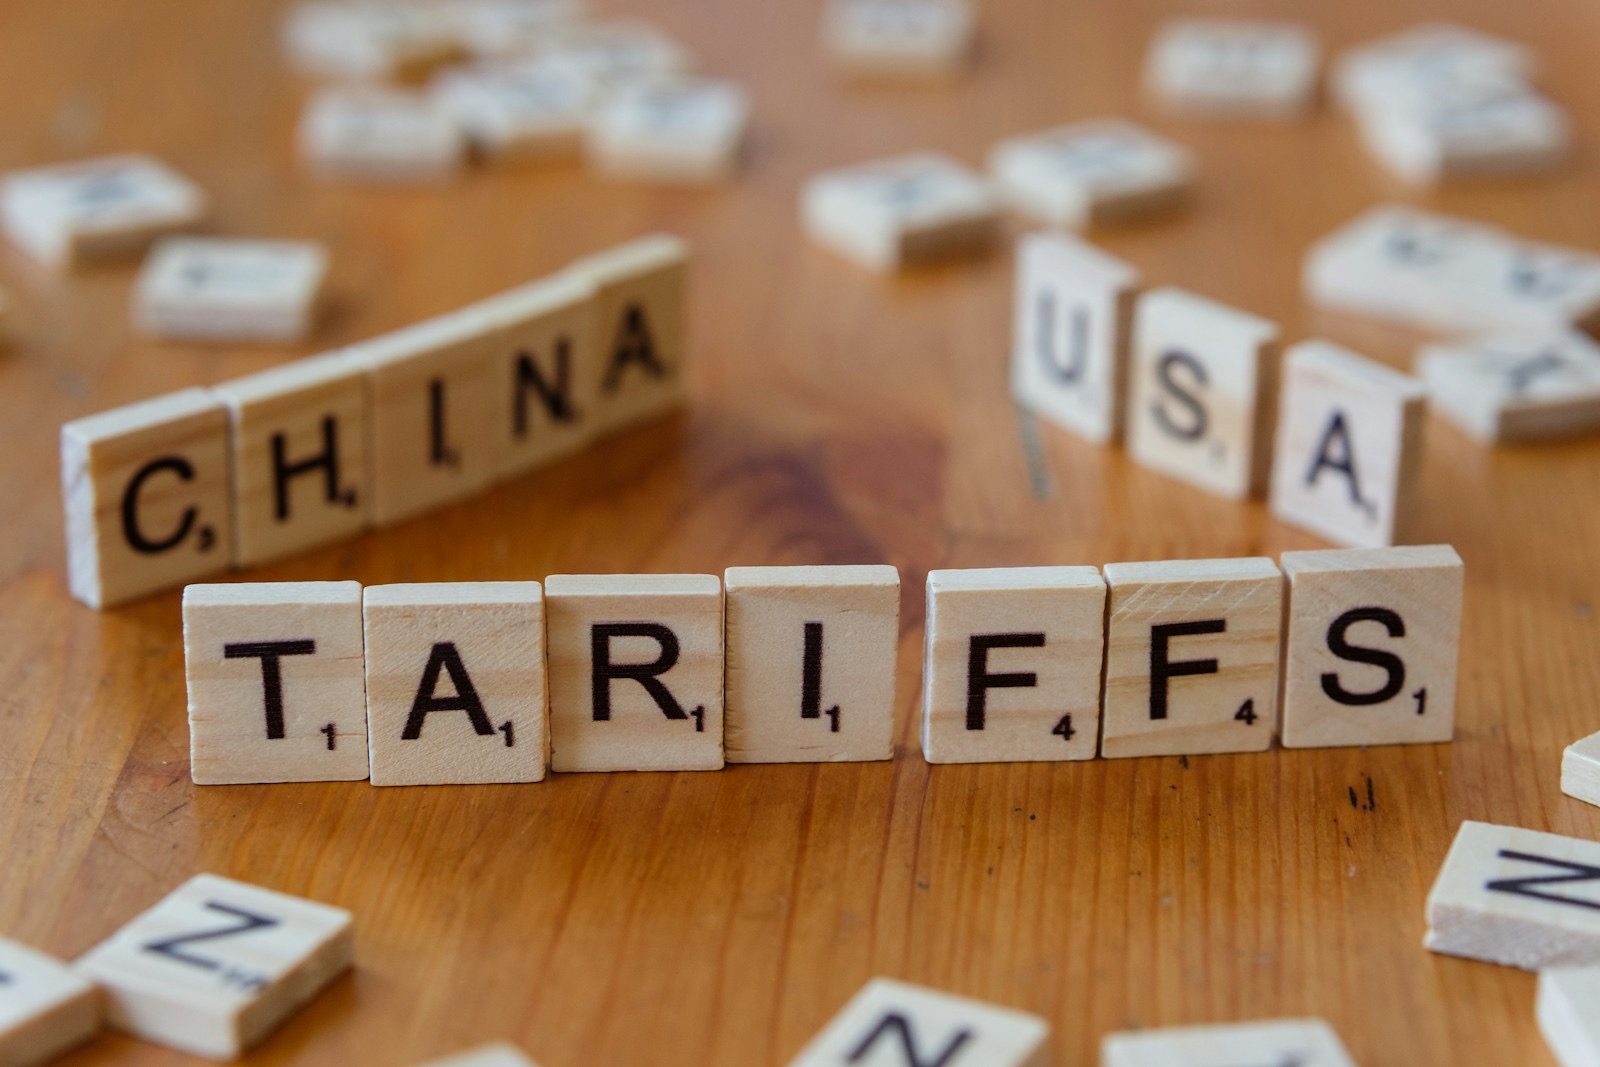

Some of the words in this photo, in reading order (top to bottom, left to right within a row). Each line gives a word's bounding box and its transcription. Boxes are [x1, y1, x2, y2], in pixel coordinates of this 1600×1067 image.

[1034, 292, 1366, 506] USA
[118, 303, 669, 555] CHINA
[224, 606, 1406, 741] TARIFFS
[1233, 697, 1259, 726] 4
[1411, 687, 1427, 716] 1
[690, 705, 705, 732] 1
[825, 704, 840, 732] 1
[1052, 713, 1076, 742] 4
[320, 723, 336, 751] 1
[498, 720, 515, 747] 1
